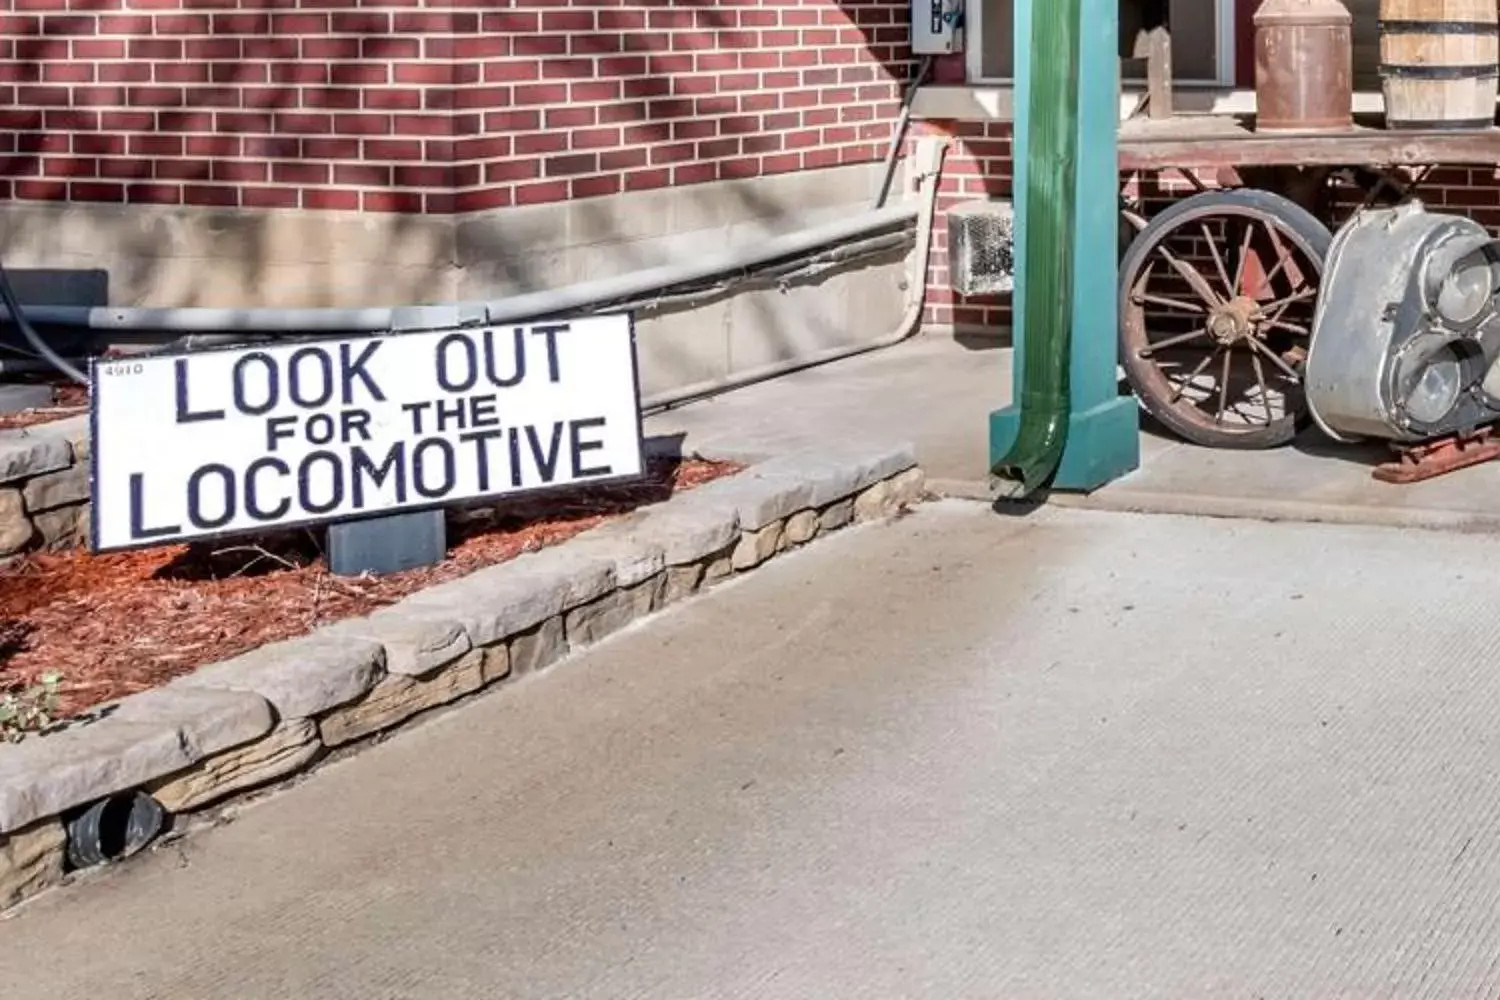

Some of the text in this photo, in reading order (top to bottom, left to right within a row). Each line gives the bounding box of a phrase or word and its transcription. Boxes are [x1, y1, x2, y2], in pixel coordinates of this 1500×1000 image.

[175, 324, 571, 424] LOOK OUT
[266, 393, 500, 452] FOR THE
[129, 416, 612, 539] LOCOMOTIVE
